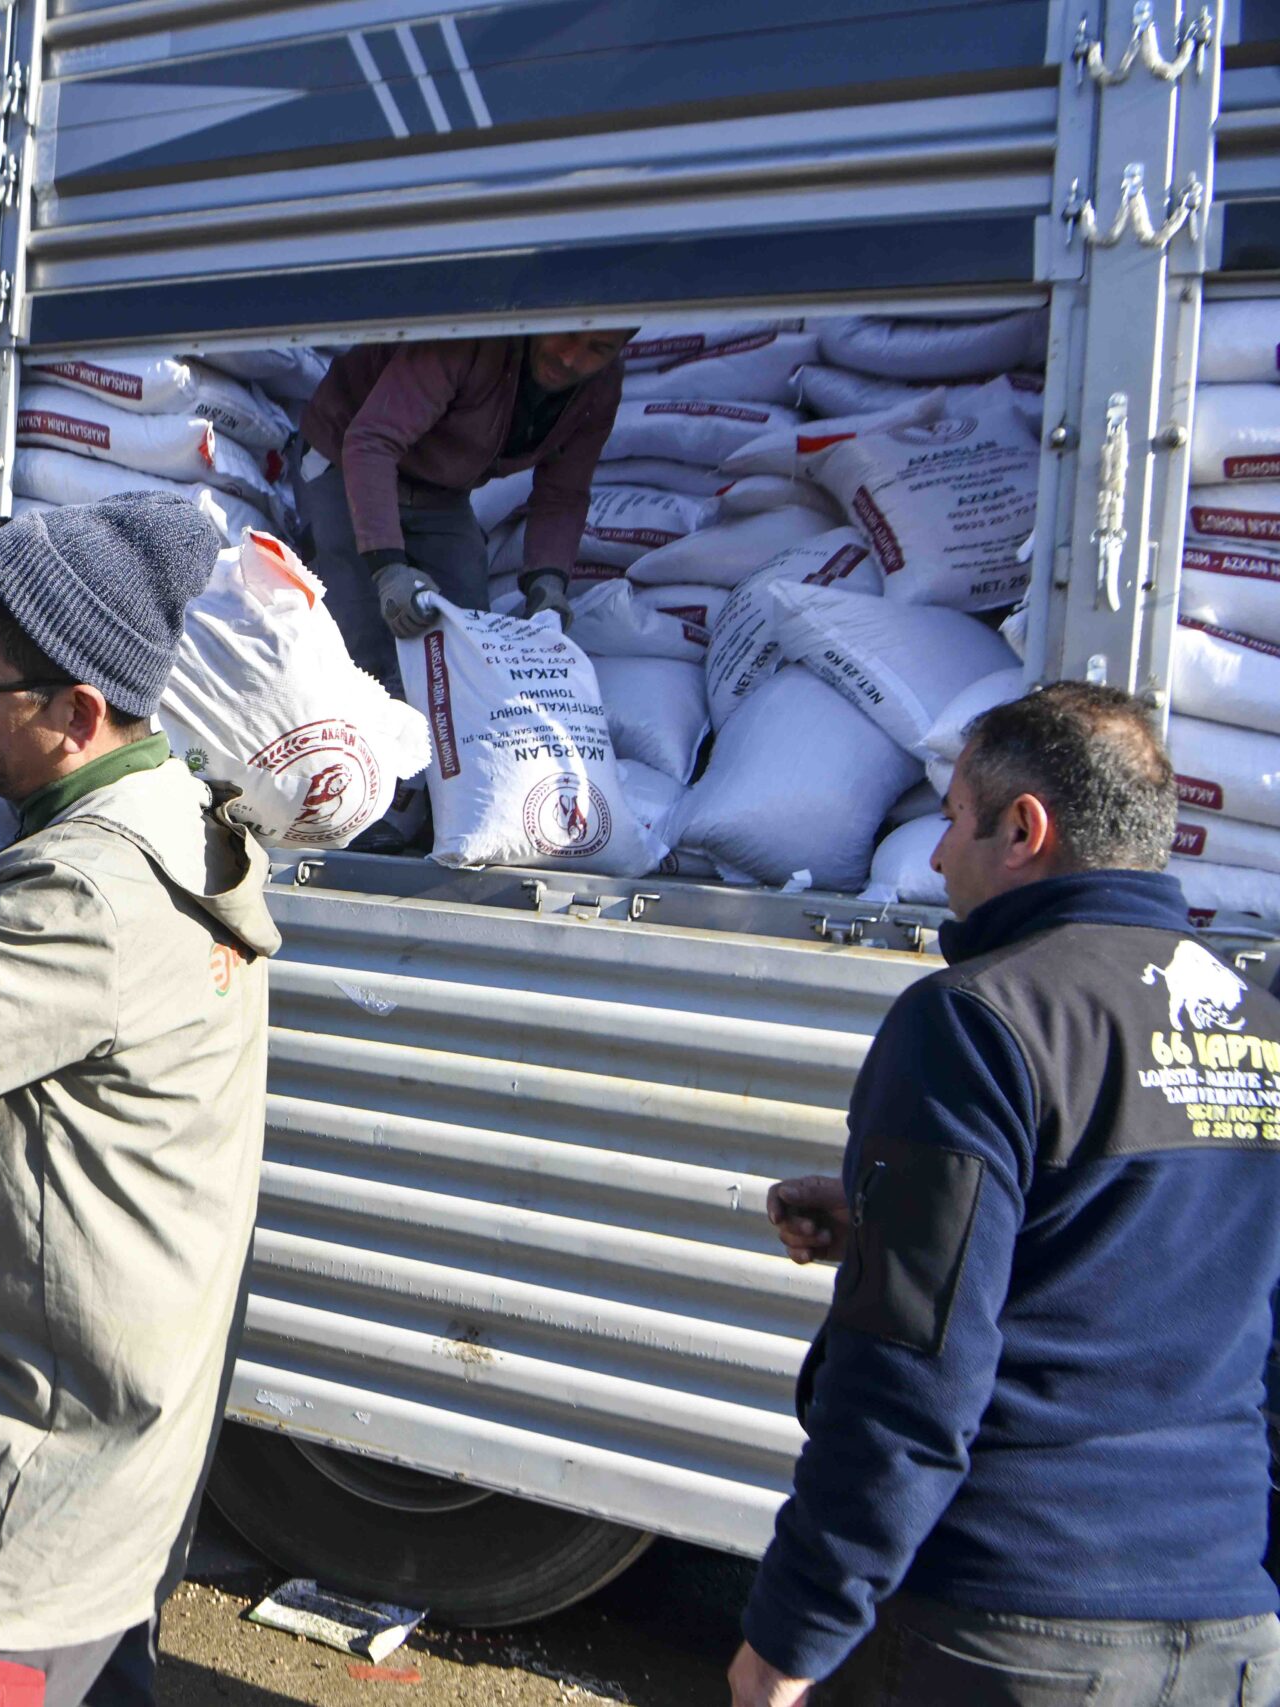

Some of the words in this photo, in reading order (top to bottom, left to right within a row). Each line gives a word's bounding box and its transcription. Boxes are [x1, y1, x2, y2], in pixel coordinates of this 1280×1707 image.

[100, 374, 138, 395] AKARSLAN
[47, 417, 69, 433] TARIM
[70, 423, 106, 443] AKARSLAN
[509, 667, 568, 681] AZKAN
[520, 688, 576, 700] TOHUMU
[490, 705, 533, 720] NOHUT
[435, 712, 449, 741] AZKAN
[441, 741, 456, 772] NOHUT
[515, 744, 605, 762] AKARSLAN
[1151, 1032, 1193, 1066] 66
